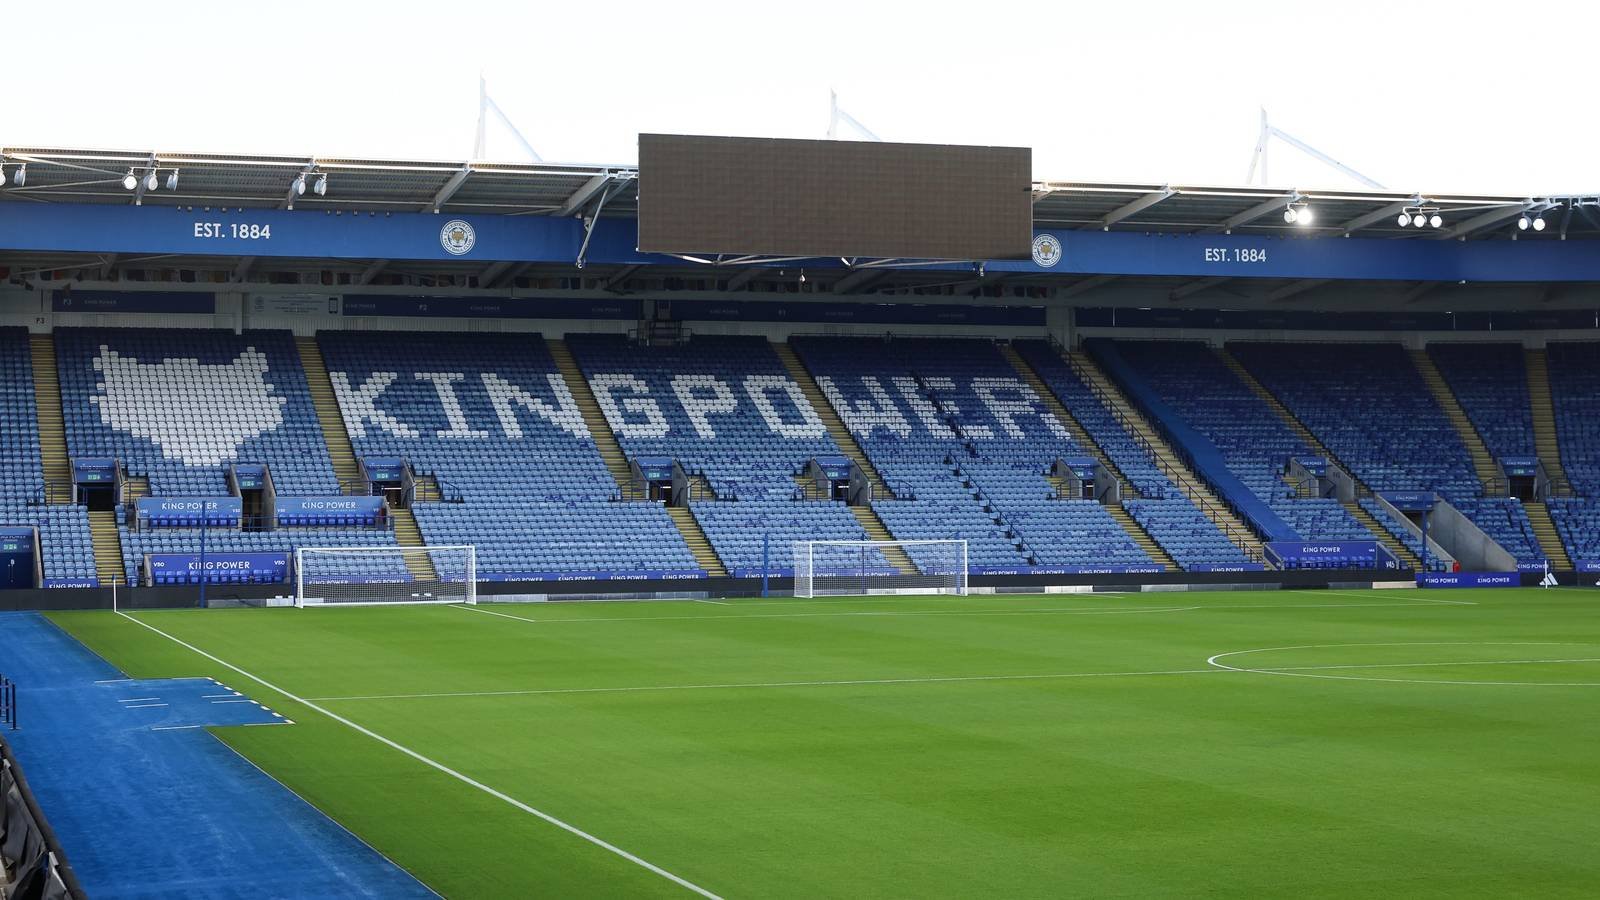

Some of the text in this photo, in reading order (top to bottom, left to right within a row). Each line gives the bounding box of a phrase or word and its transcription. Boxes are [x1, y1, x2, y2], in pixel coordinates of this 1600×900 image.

[194, 222, 271, 239] EST. 1884
[1205, 247, 1267, 262] EST. 1884
[161, 502, 185, 510] KING
[302, 501, 356, 510] KING POWER
[216, 561, 250, 570] POWER
